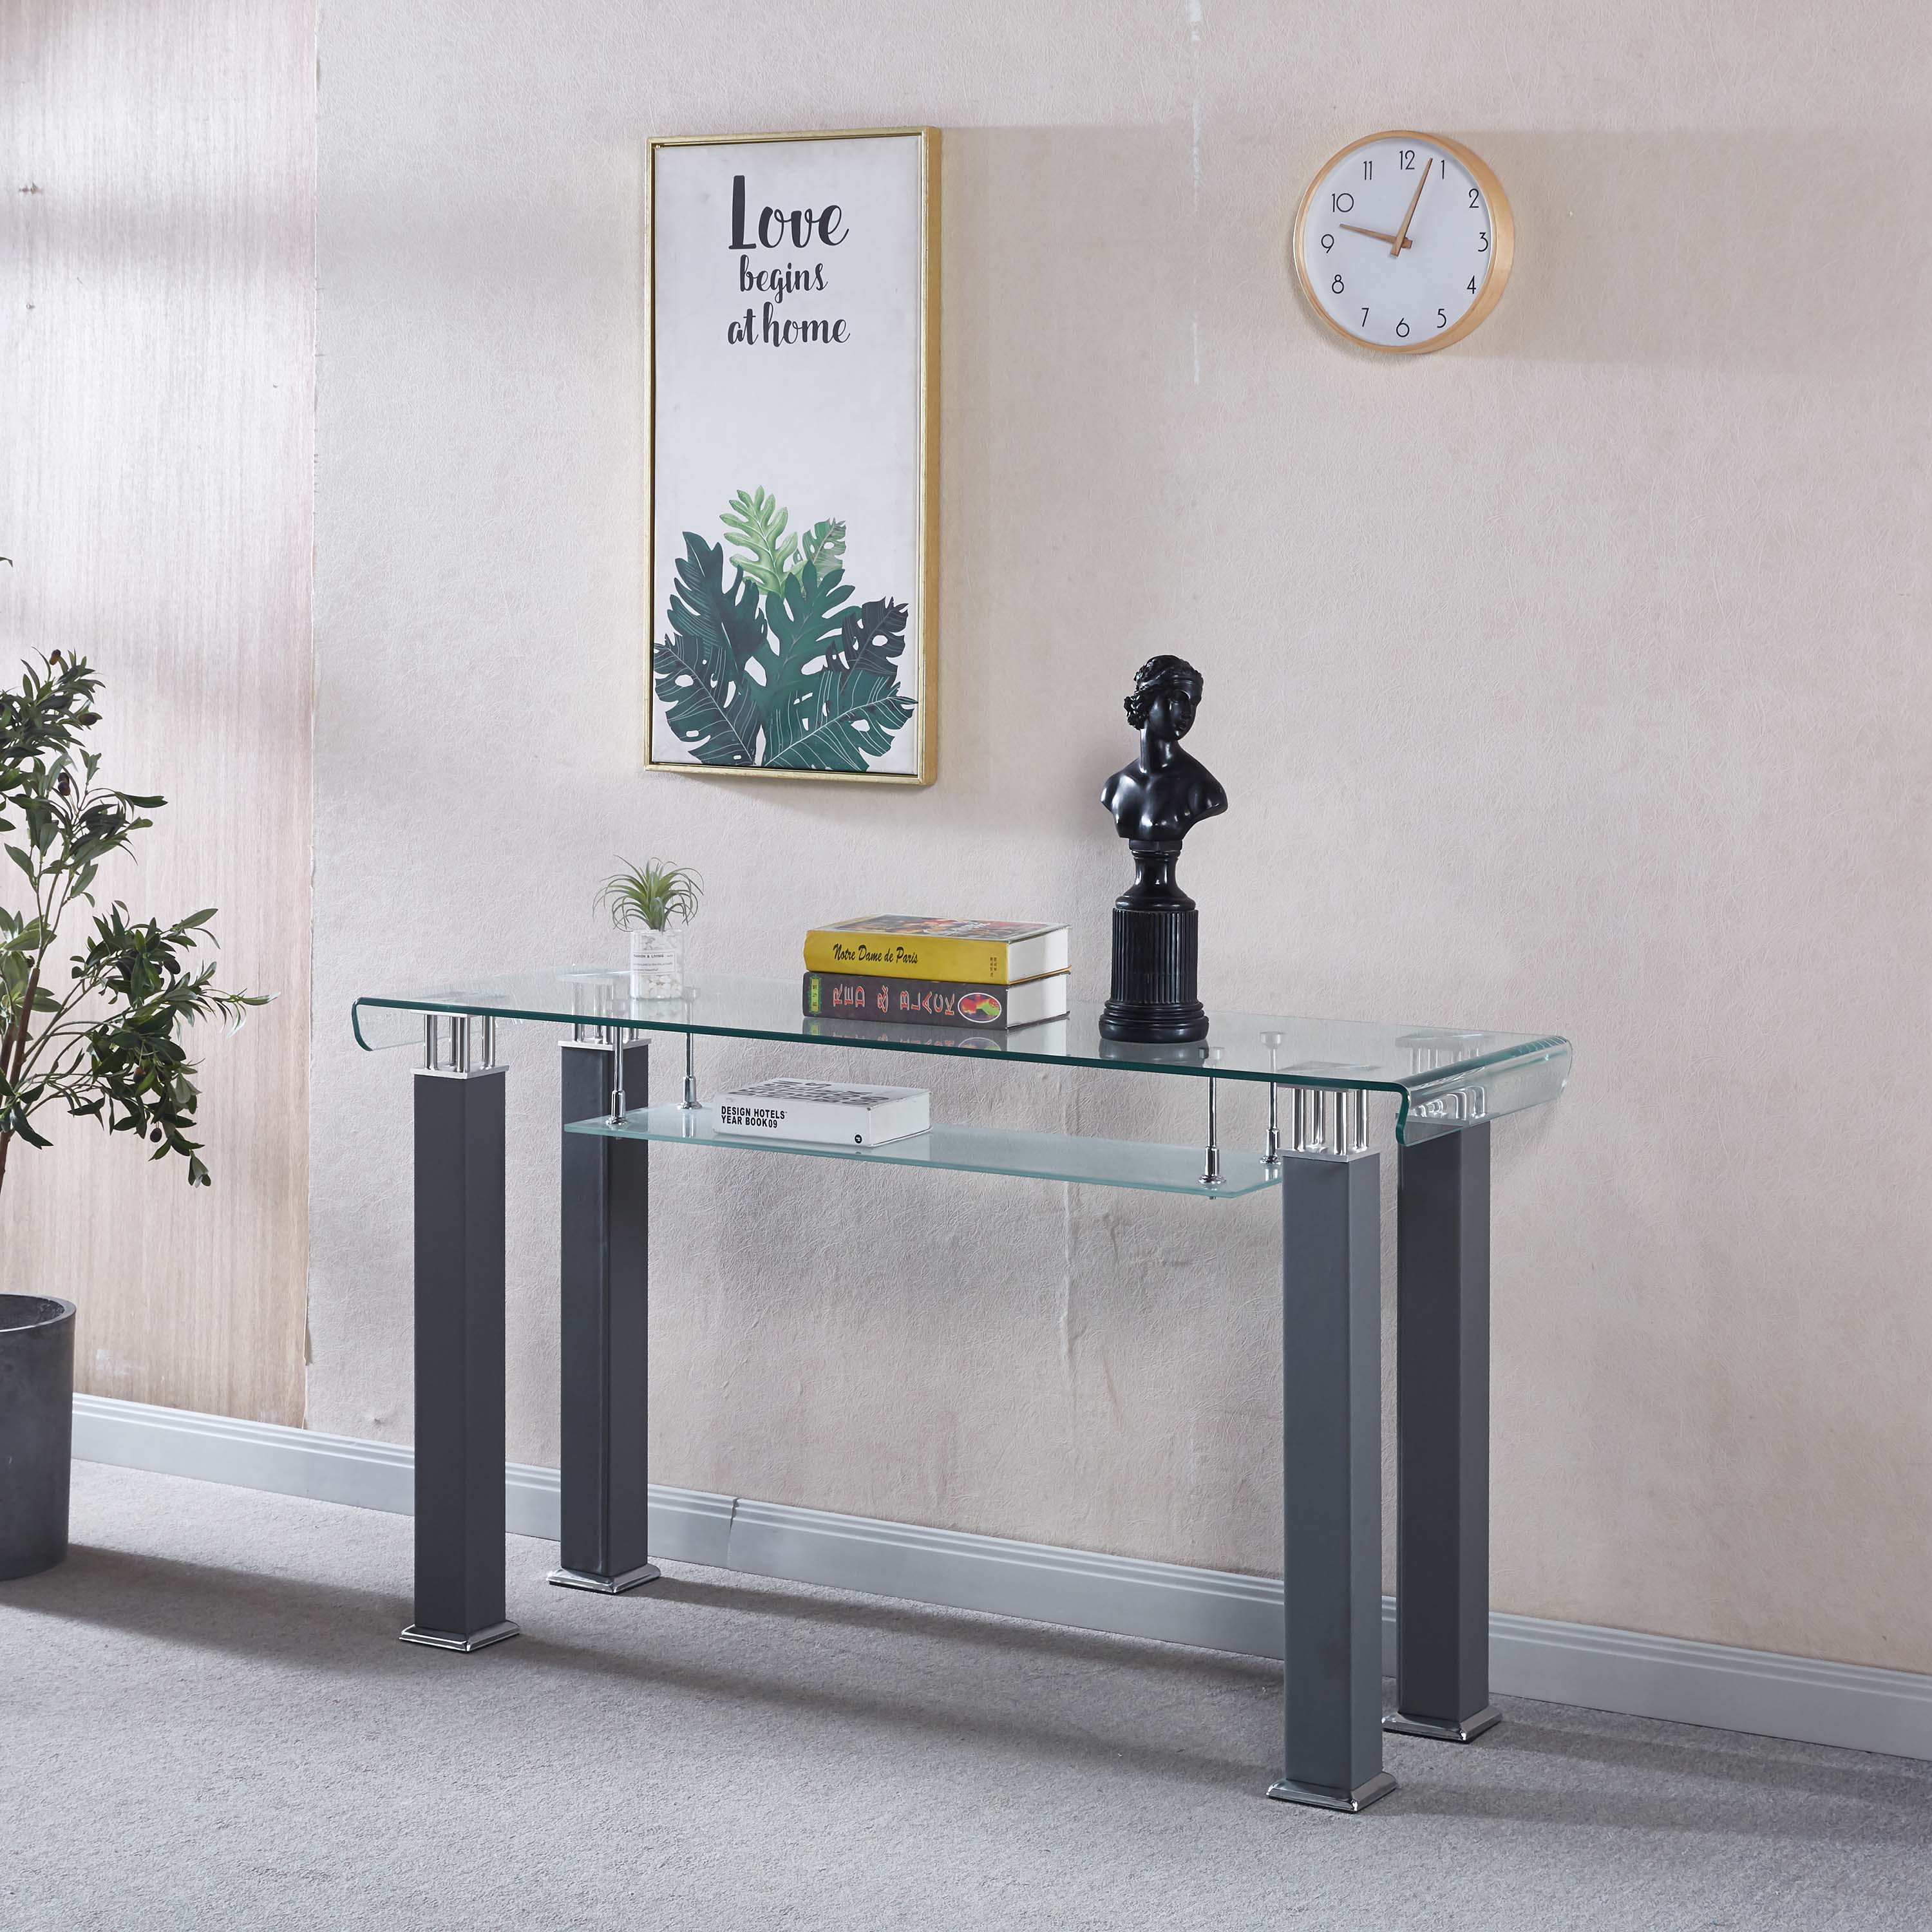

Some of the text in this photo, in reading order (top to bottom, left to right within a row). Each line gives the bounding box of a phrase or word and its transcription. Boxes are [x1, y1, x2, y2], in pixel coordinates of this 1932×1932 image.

[1399, 149, 1415, 170] 12
[1363, 160, 1373, 180] 11
[1440, 160, 1445, 180] 1
[1331, 193, 1354, 213] 10
[1468, 188, 1479, 209] 2
[728, 175, 849, 250] Love
[1321, 234, 1335, 254] 9
[1477, 232, 1489, 252] 3
[739, 254, 828, 303] begins
[1331, 274, 1345, 294] 8
[1466, 275, 1477, 294] 4
[727, 301, 851, 348] at home
[1361, 307, 1370, 327] 7
[1396, 317, 1410, 337] 6
[1437, 308, 1447, 328] 5
[832, 943, 918, 964] Notre Dame de Paris
[833, 983, 865, 1008] RED
[876, 985, 889, 1012] &
[900, 990, 954, 1016] BLACK
[727, 1080, 803, 1096] DESIGN
[721, 1106, 751, 1117] DESIGN
[721, 1115, 743, 1125] YEAR
